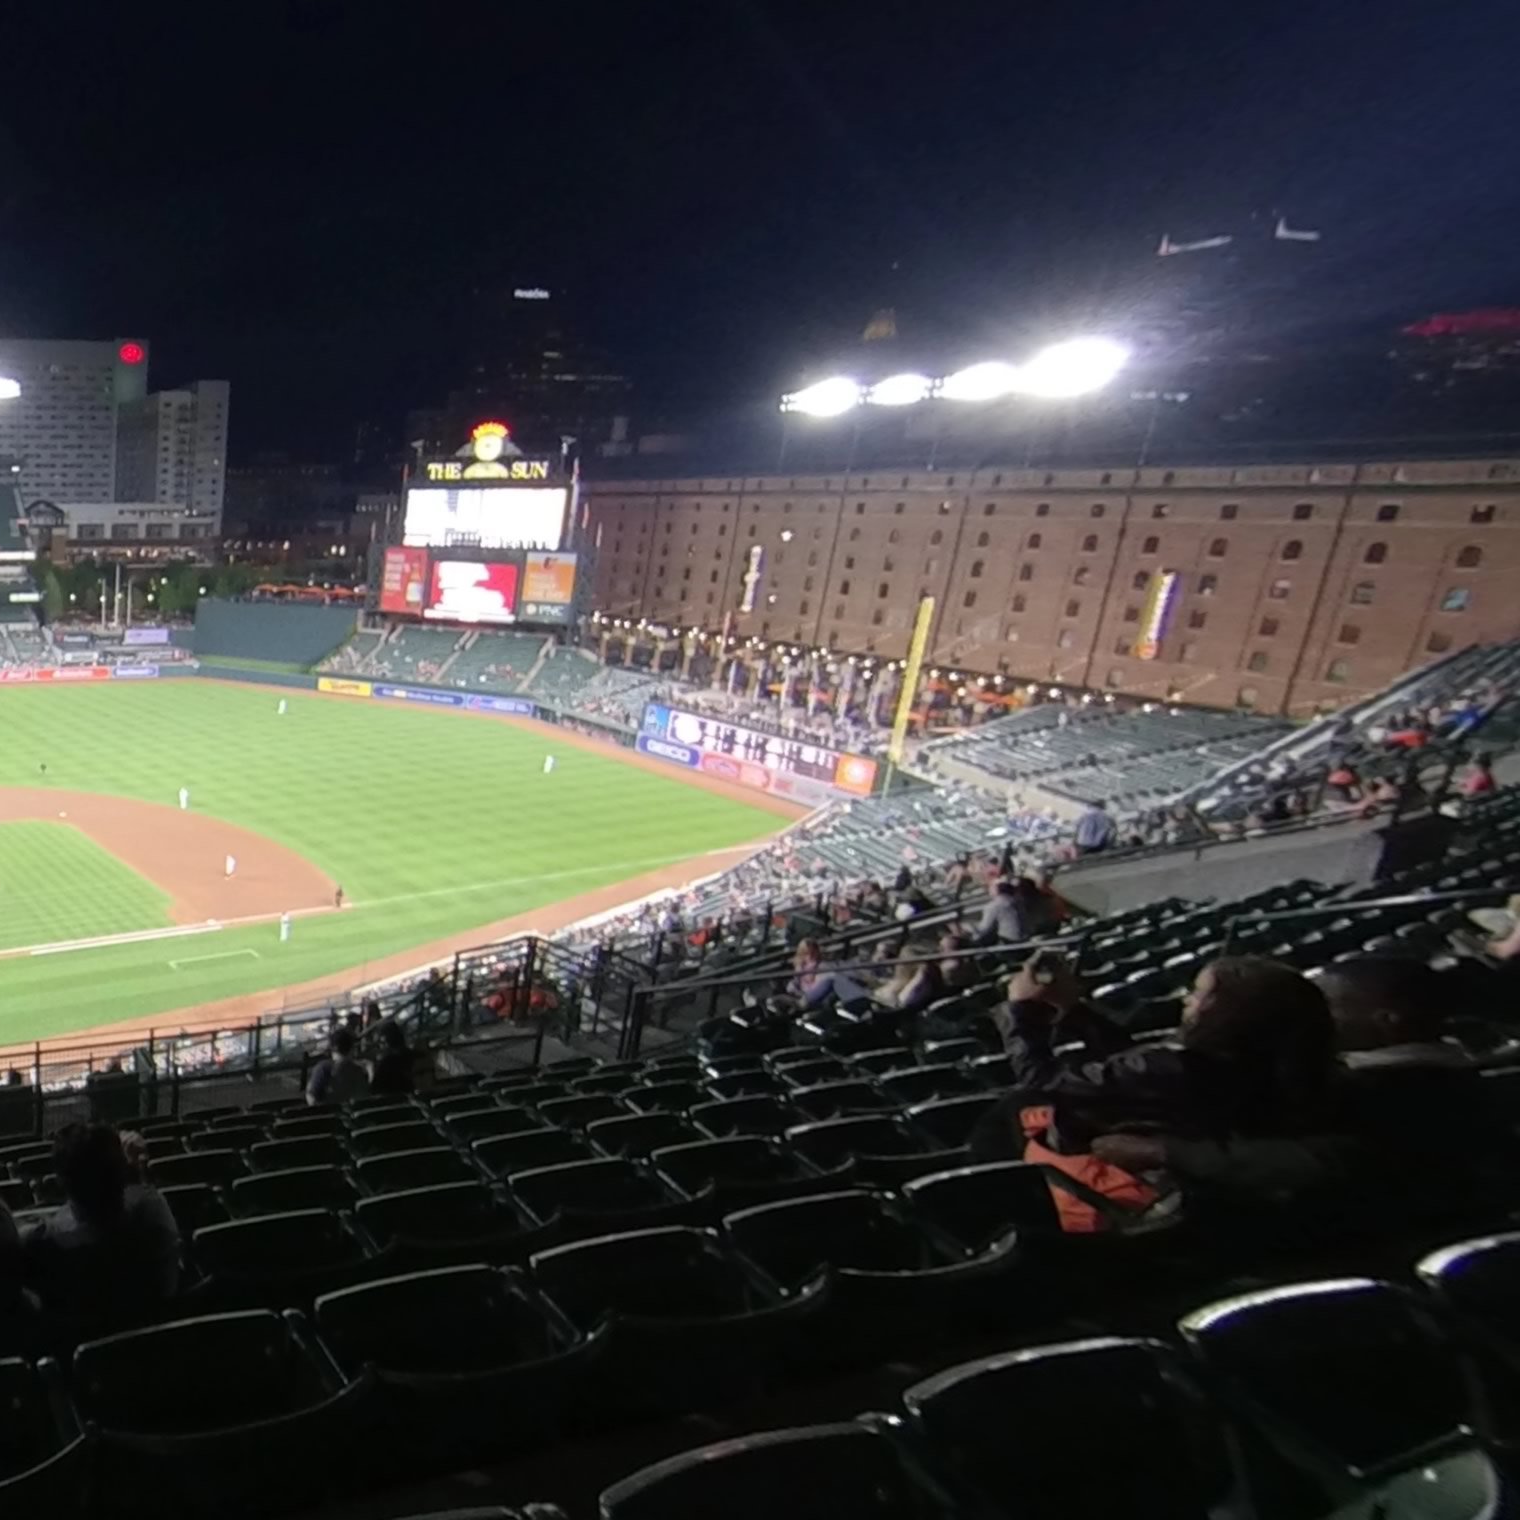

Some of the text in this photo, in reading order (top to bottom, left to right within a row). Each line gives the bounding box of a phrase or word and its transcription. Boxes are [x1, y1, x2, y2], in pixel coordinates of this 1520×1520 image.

[427, 461, 549, 480] THE SUN
[538, 604, 564, 617] PNC
[646, 739, 690, 762] GEICO
